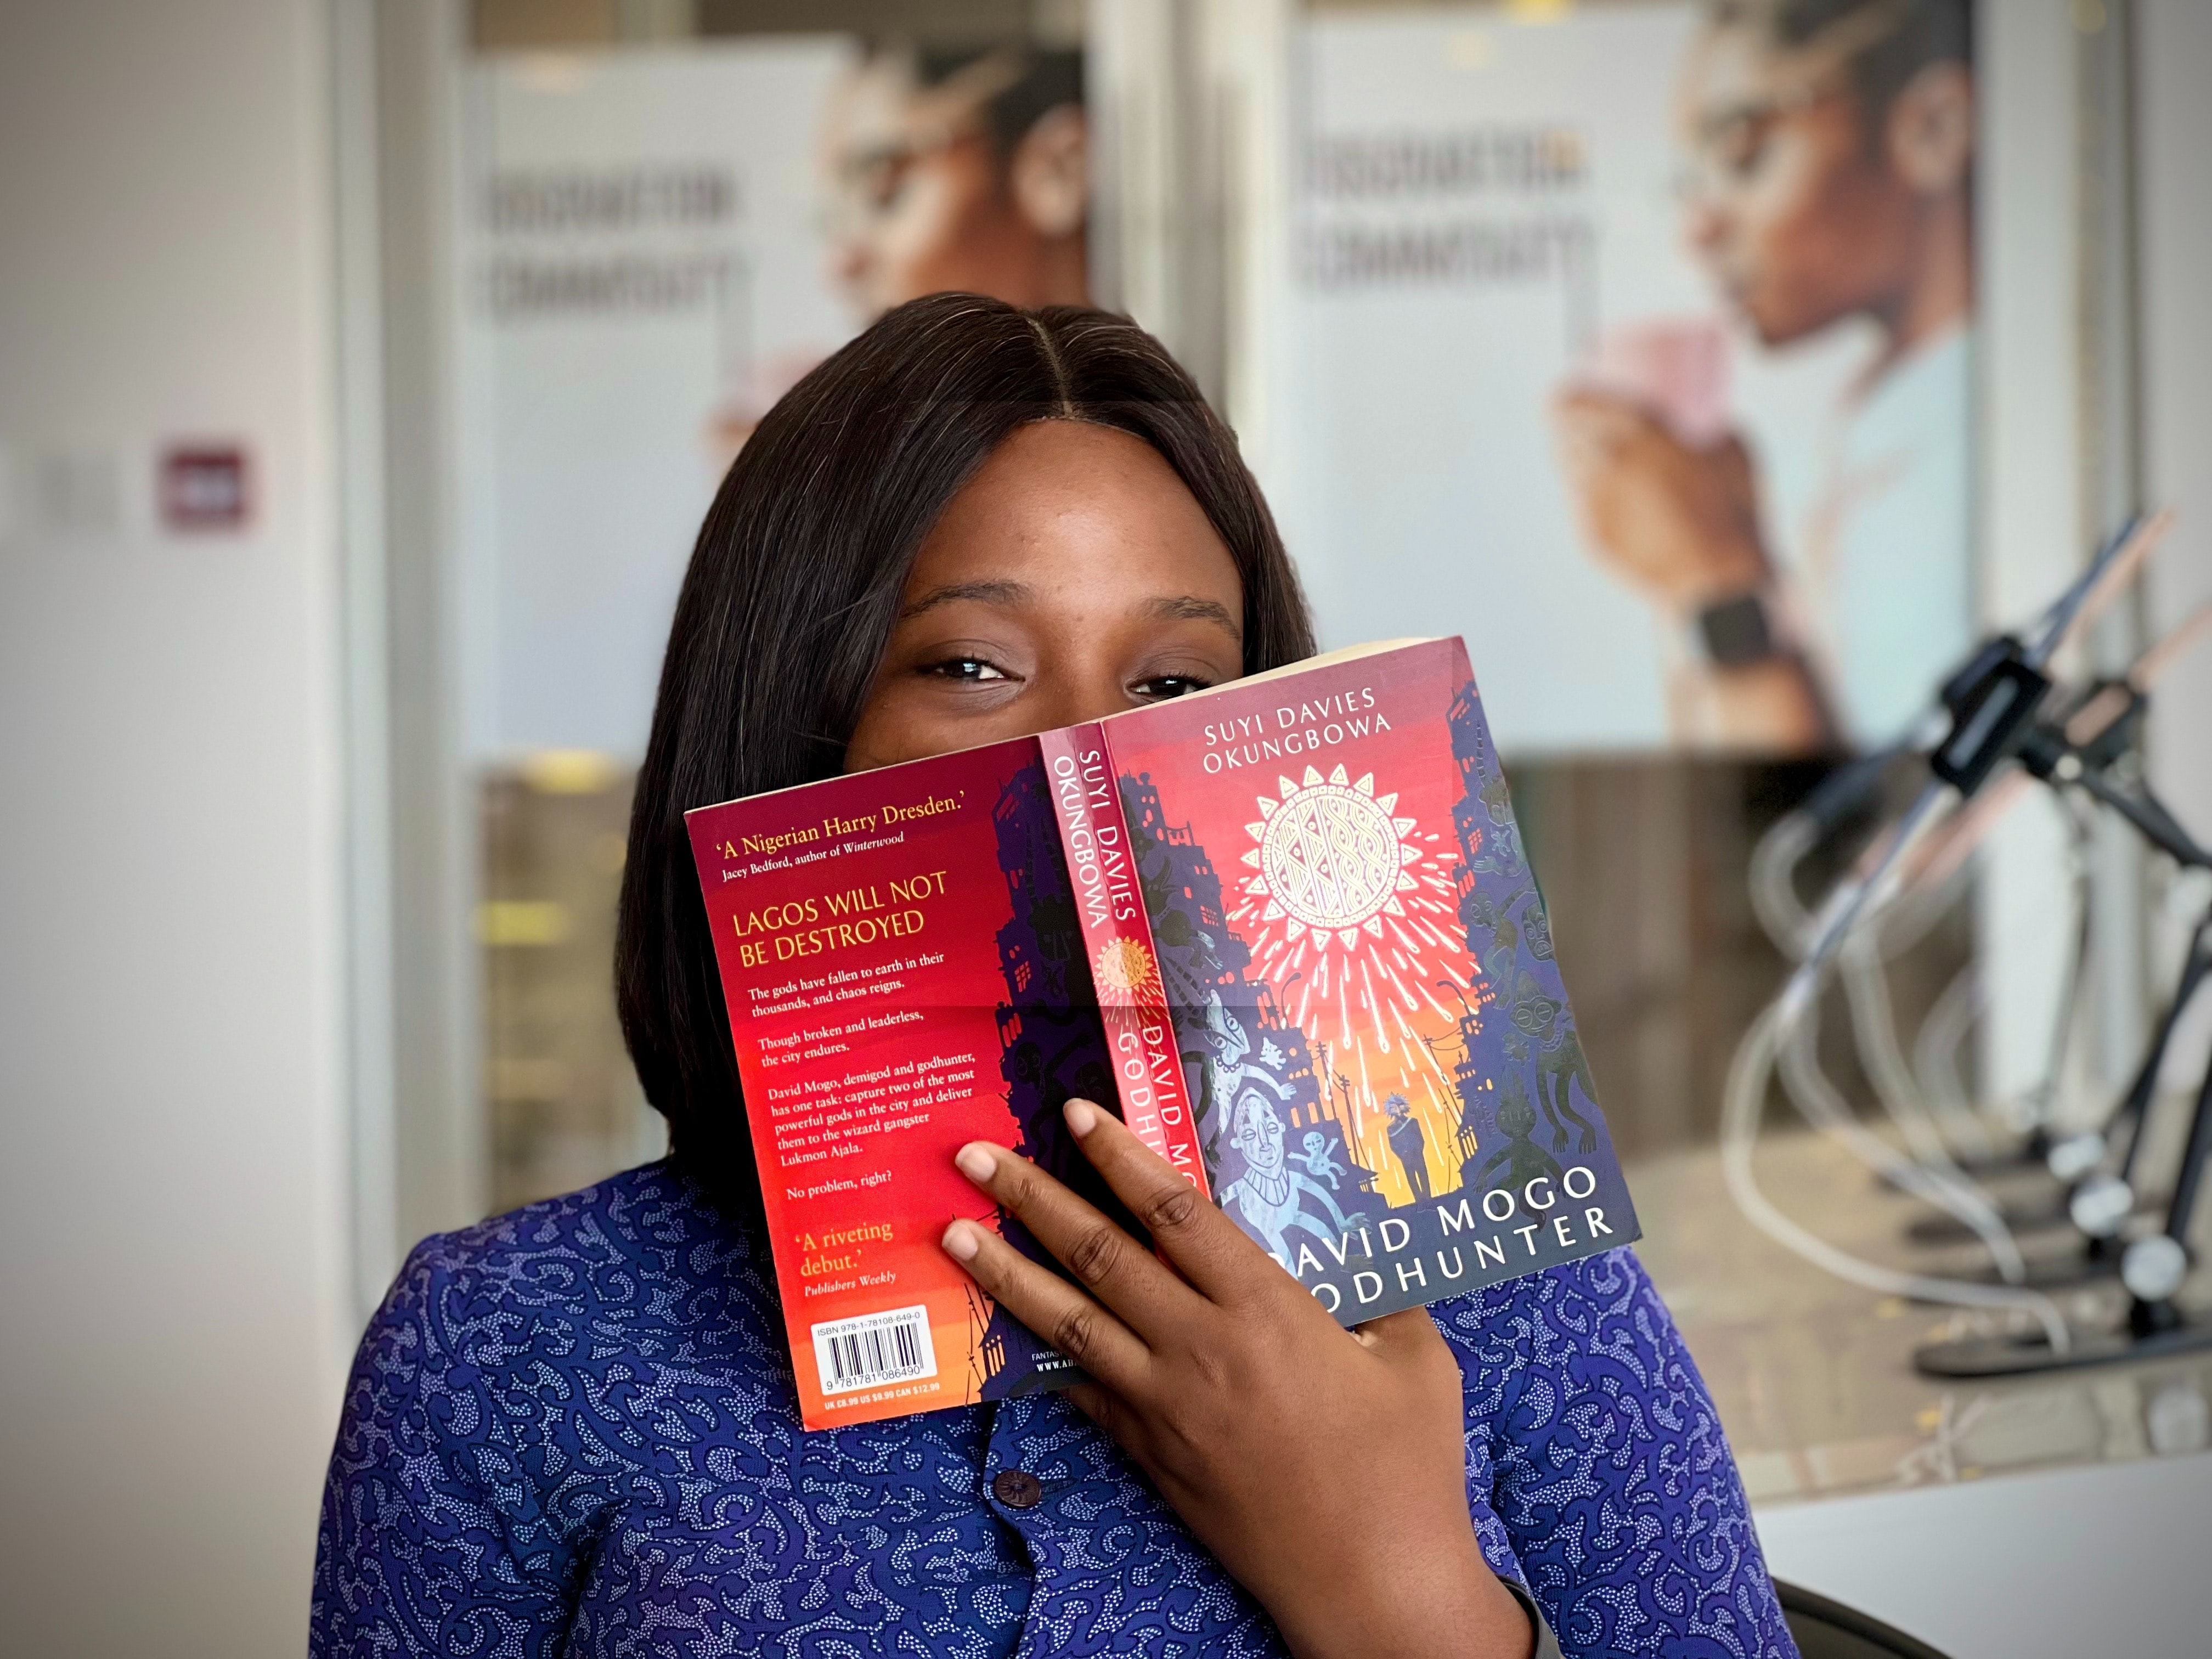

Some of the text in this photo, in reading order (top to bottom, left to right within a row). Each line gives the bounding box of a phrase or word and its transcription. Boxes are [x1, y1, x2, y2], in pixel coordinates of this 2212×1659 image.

[1205, 687, 1375, 746] SUYI DAVIES
[1203, 713, 1391, 774] OKUNGBOWA
[722, 832, 904, 882] Jacey Bedford, author of Winterwood
[742, 827, 820, 855] Nigerian
[823, 814, 876, 836] Harry
[1053, 756, 1108, 928] OKUNGBOWA
[1079, 750, 1136, 921] SUYI DAVIES
[733, 871, 947, 936] LAGOS WILL NOT
[740, 910, 924, 967] BE DESTROYED
[747, 952, 944, 1001] The gods have fallen to earth in their
[752, 980, 905, 1017] thousands, and chaos reigns.
[758, 1011, 924, 1051] Though broken and leaderless,
[761, 1043, 850, 1068] the city endures.
[768, 1054, 975, 1101] David Mogo, demigod and godhunter,
[1142, 1025, 1182, 1125] DAVID
[771, 1070, 974, 1117] has one task: capture two of the most
[775, 1087, 973, 1136] powerful gods in the city and deliver
[777, 1113, 929, 1150] them to the wizard gangster
[781, 1144, 863, 1167] Lukmon Ajala.
[787, 1170, 891, 1200] No problem, right?
[823, 1222, 893, 1248] riveting
[1268, 1166, 1596, 1277] AVID MOGO
[1310, 1207, 1613, 1313] ODHUNTER
[804, 1271, 896, 1297] Publishers Weekly
[817, 1311, 921, 1336] ISBN 978-1-78108-649-0
[839, 1375, 876, 1388] 781781
[882, 1366, 920, 1380] 086490
[1036, 1358, 1077, 1372] WWW.AB
[837, 1398, 858, 1407] £8.99
[872, 1392, 894, 1402] $9.99
[896, 1389, 911, 1397] CAN
[913, 1383, 940, 1394] $12.99
